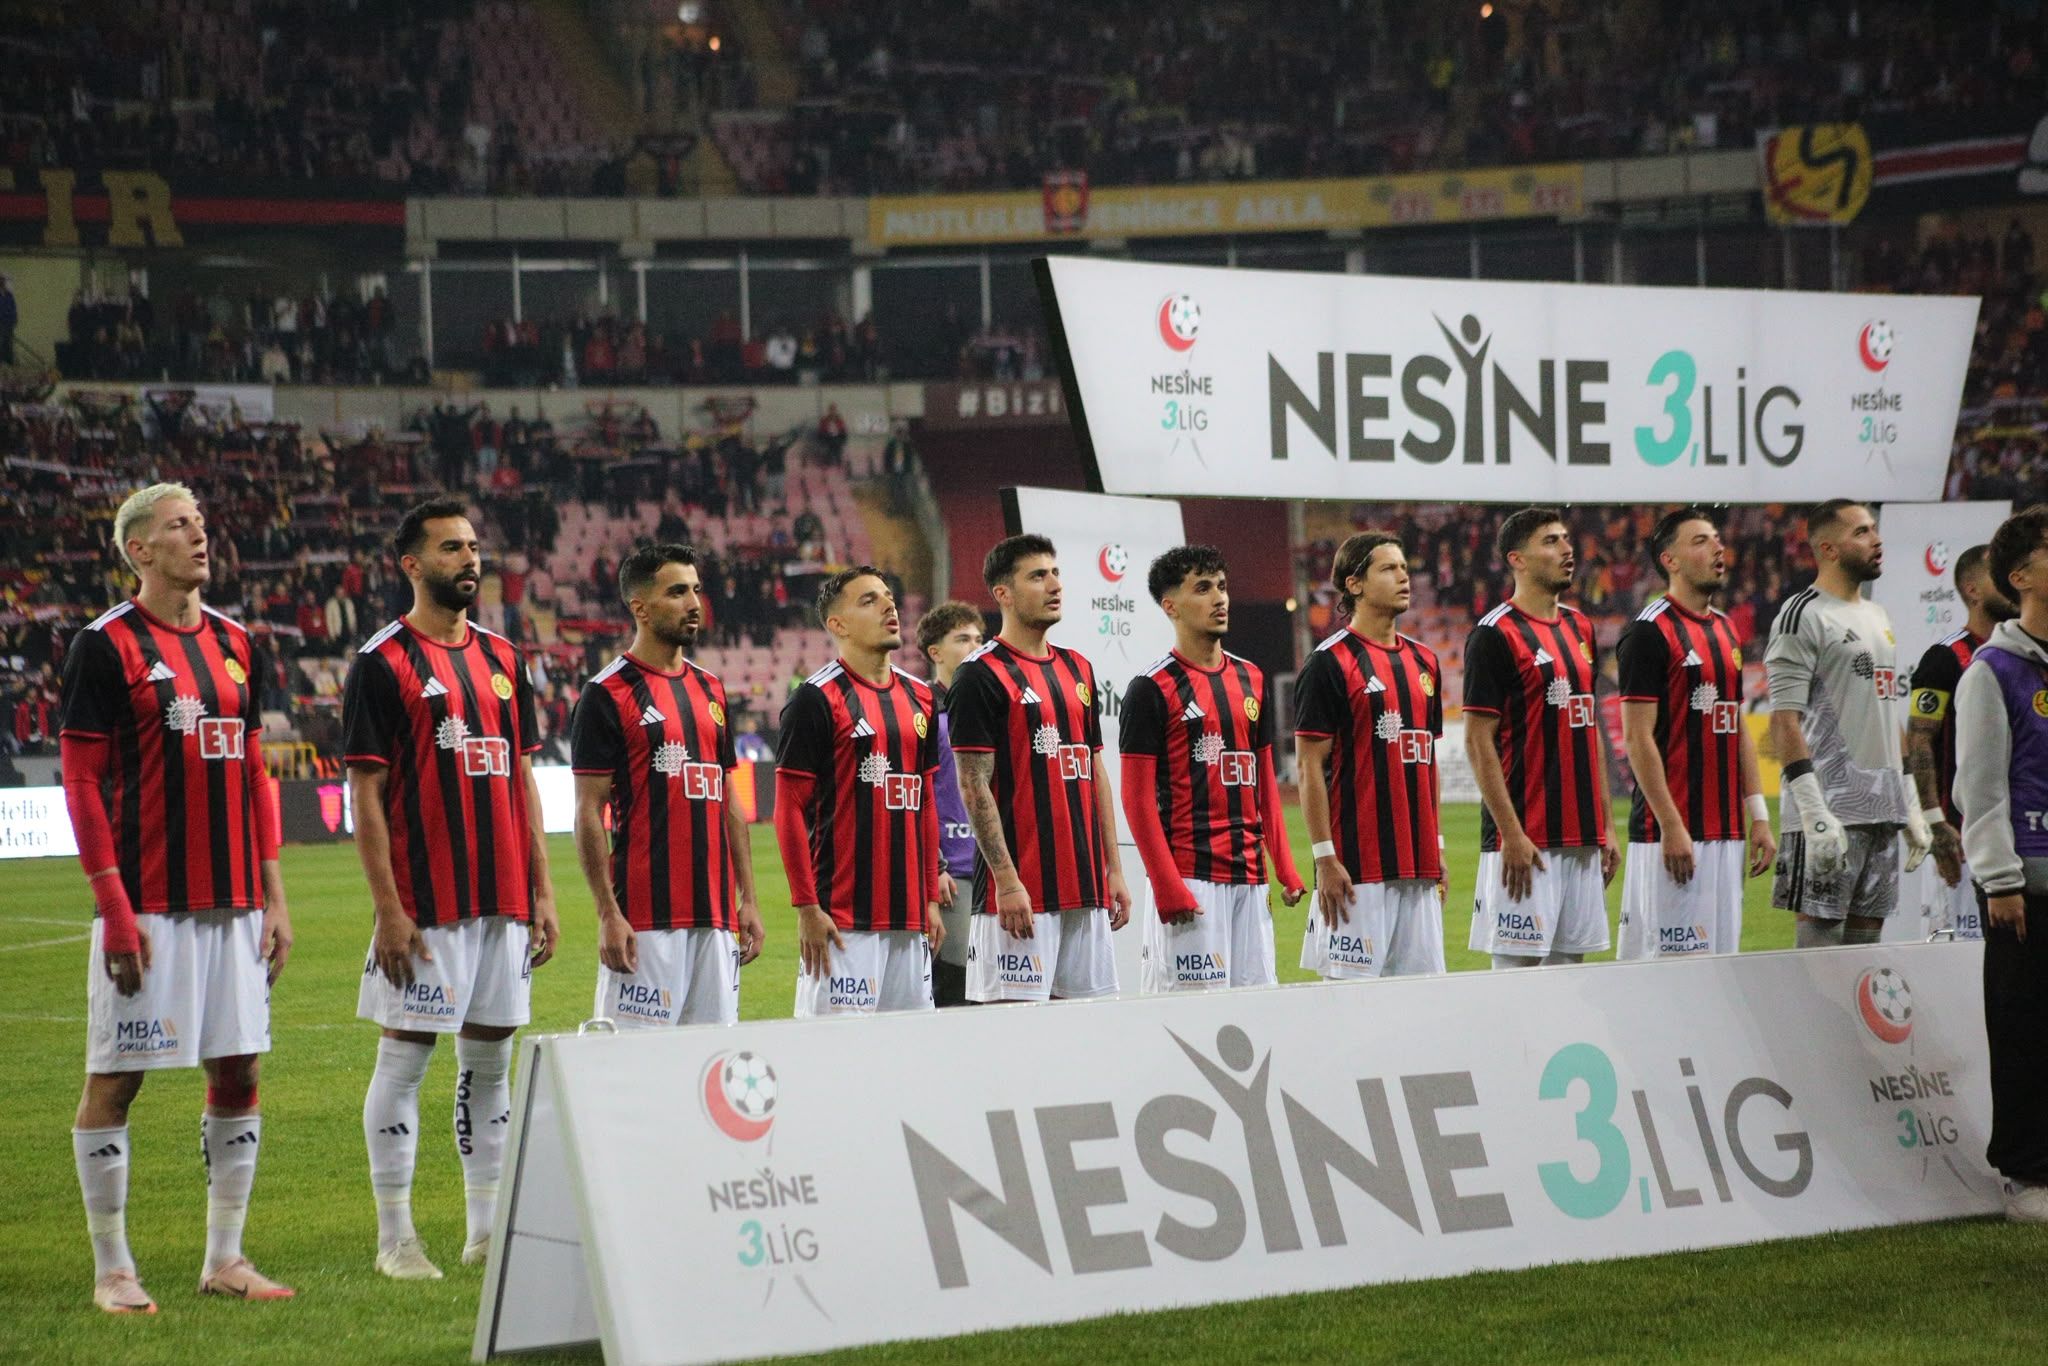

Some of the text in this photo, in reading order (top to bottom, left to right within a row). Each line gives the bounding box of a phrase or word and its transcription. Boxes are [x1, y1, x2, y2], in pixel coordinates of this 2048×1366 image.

[1498, 912, 1535, 931] MBA
[1956, 914, 1978, 929] MB
[1660, 926, 1697, 942] MBA
[1329, 934, 1364, 954] MBA
[997, 953, 1033, 972] MBA
[1176, 953, 1214, 971] MBA
[830, 977, 869, 995] MBA
[1000, 973, 1042, 983] KULLARI
[405, 983, 444, 1003] MBA
[620, 982, 660, 1006] MBA
[118, 1019, 163, 1040] MBA
